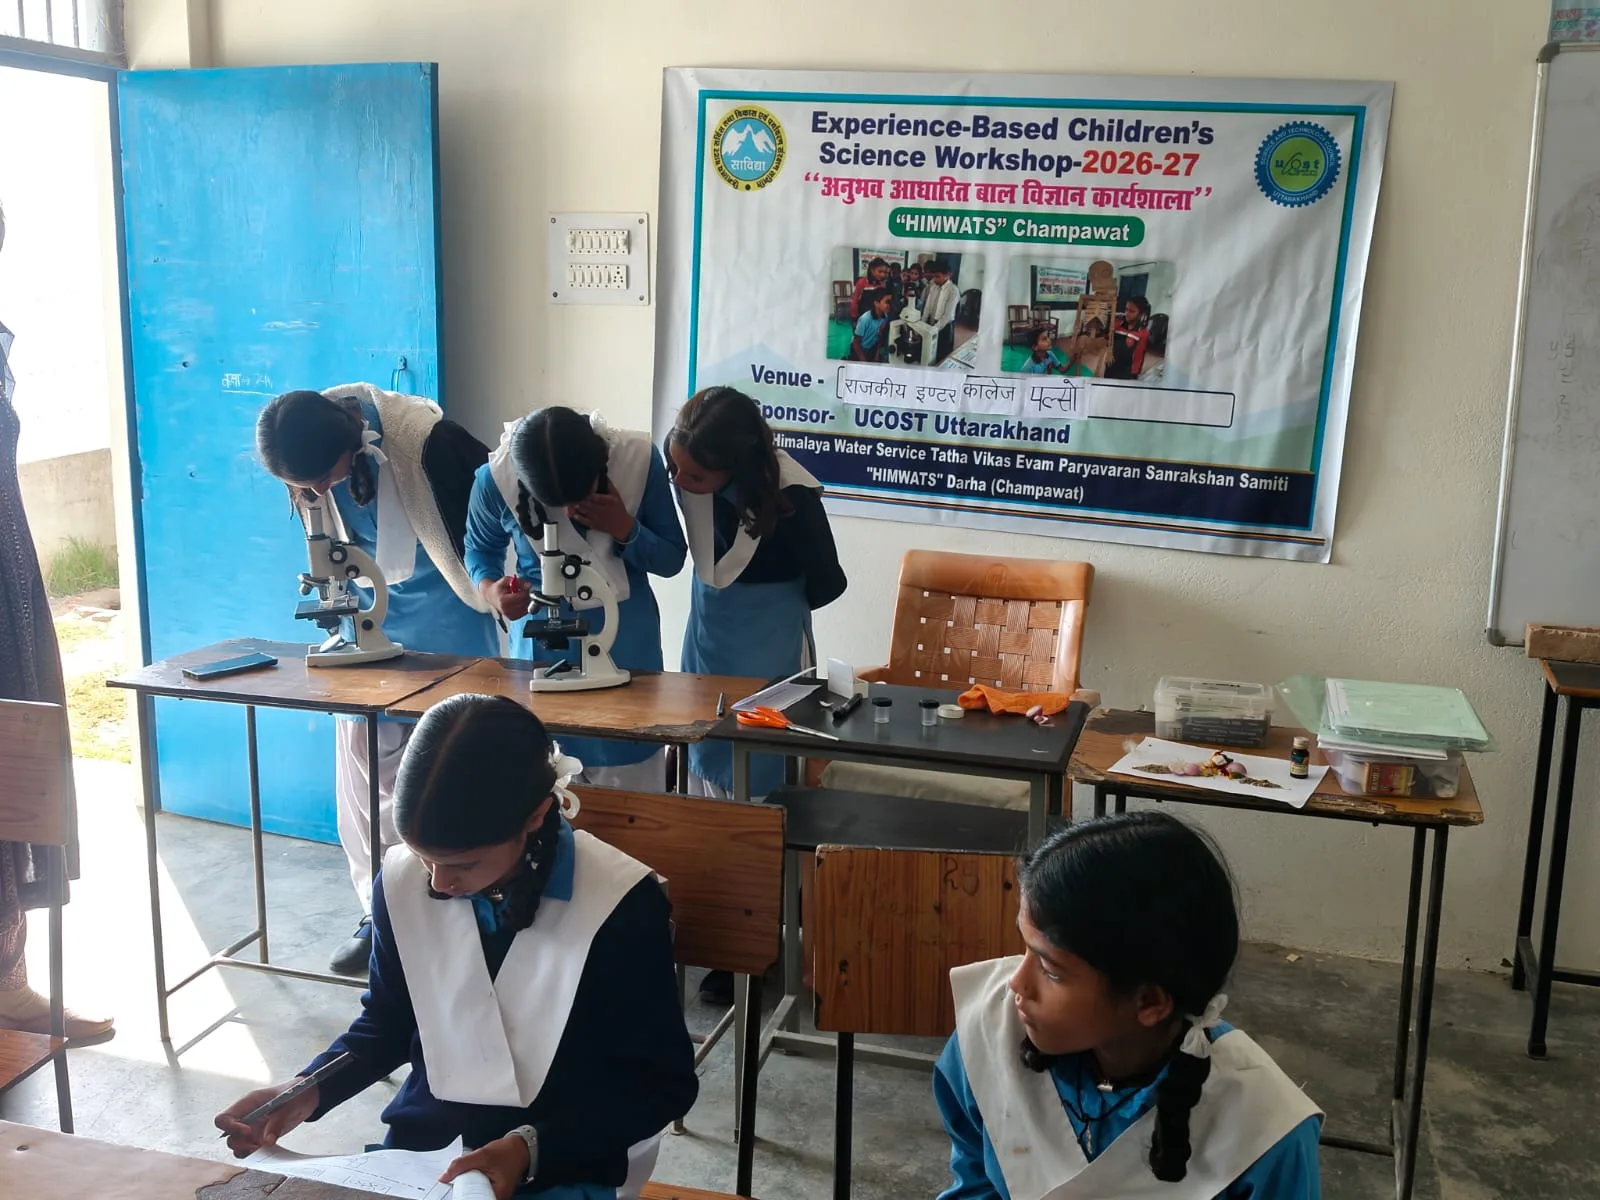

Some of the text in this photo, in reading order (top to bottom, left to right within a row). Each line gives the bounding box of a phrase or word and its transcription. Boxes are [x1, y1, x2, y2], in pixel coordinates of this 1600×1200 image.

[811, 111, 1214, 145] Experience-Based Children’s
[819, 141, 1200, 178] Science Workshop-2026-27
[975, 183, 1018, 204] बाल
[1022, 179, 1087, 206] विज्ञान
[896, 214, 1130, 242] “HIMWATS” Champawat
[751, 364, 812, 387] Venue
[845, 377, 907, 399] राजकीय
[915, 386, 957, 403] इण्टर
[963, 378, 1016, 401] कालेज
[855, 408, 928, 432] UCOST
[935, 414, 1071, 444] Uttarakhand
[772, 432, 1289, 491] Himalaya Water Service Tatha Vikas Evam Paryavaran Sanrakshan Samiti
[866, 466, 1084, 504] "HIMWATS" Darha (Champawat)
